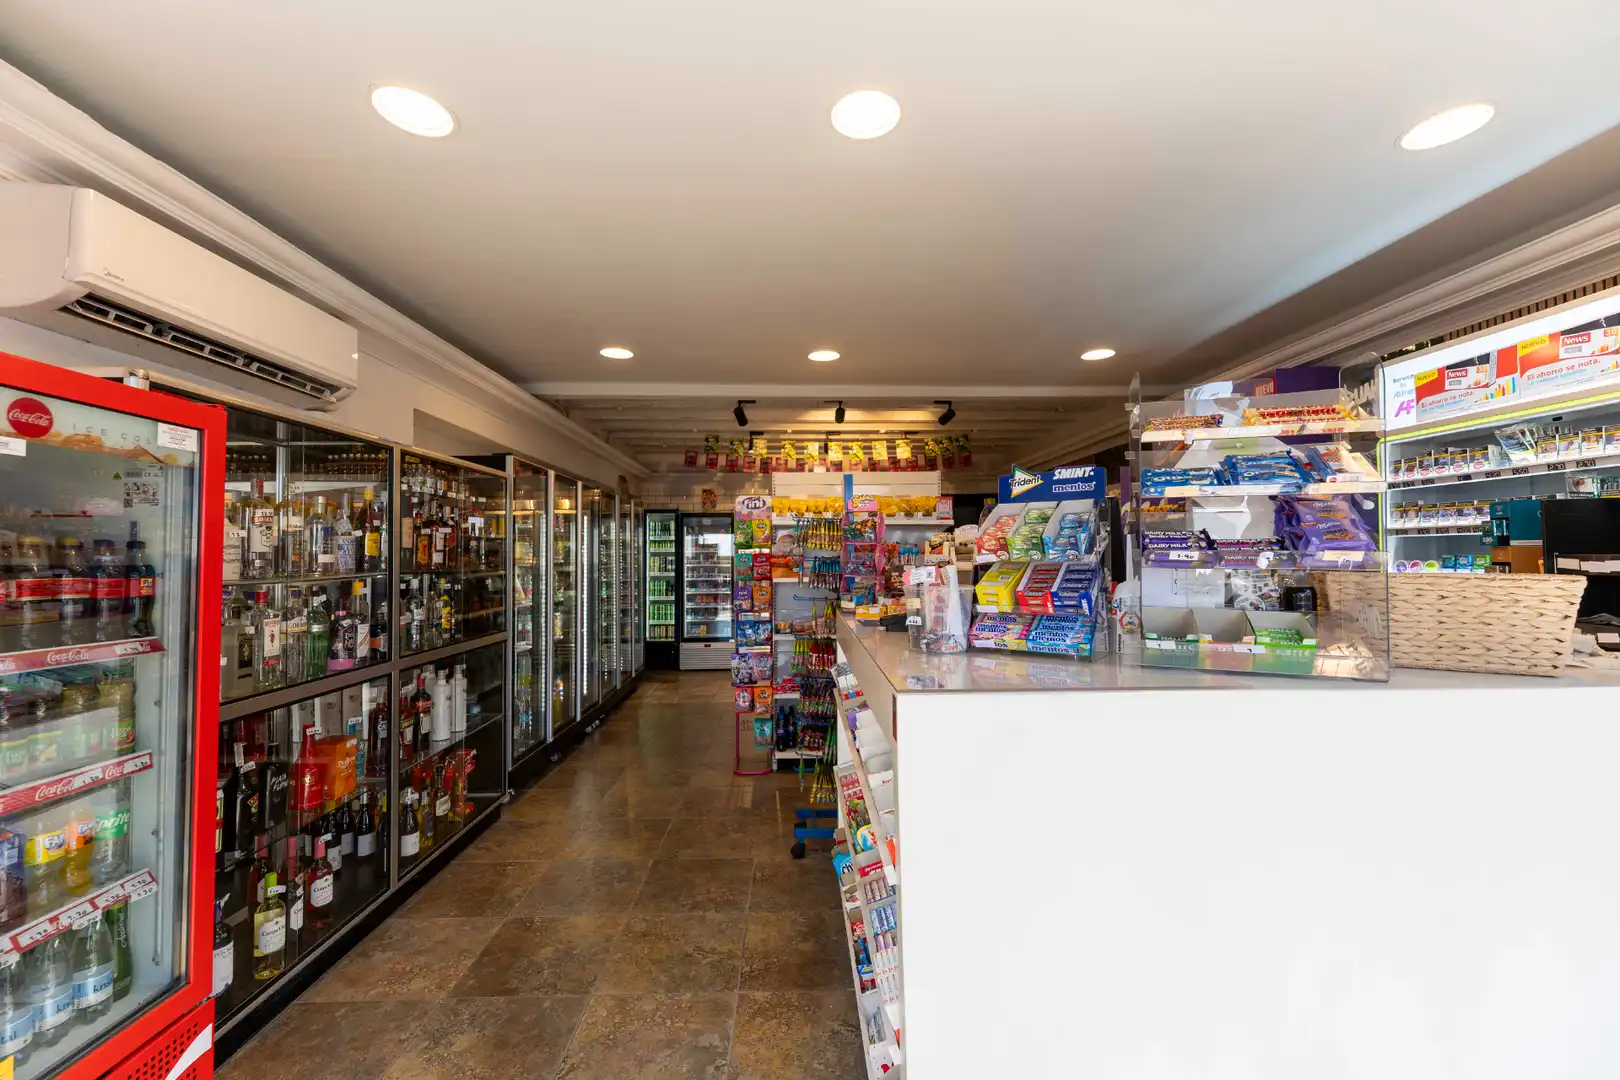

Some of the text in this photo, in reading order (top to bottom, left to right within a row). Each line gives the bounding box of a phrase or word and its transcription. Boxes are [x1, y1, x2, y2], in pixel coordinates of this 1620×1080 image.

[1521, 339, 1546, 350] NUEVO
[1563, 334, 1589, 345] News
[1447, 370, 1466, 378] News
[1536, 368, 1563, 379] ahorro
[1578, 359, 1601, 369] nota.
[8, 408, 50, 427] Coca-Cola
[73, 423, 108, 436] ICE
[1053, 466, 1092, 480] SMINT
[1009, 474, 1041, 488] Trident
[1053, 482, 1094, 493] mentos
[743, 497, 765, 509] fini
[47, 648, 89, 664] Coca-Cola
[1031, 645, 1070, 654] mentos
[36, 776, 76, 801] Coca-Col
[96, 812, 130, 829] prite
